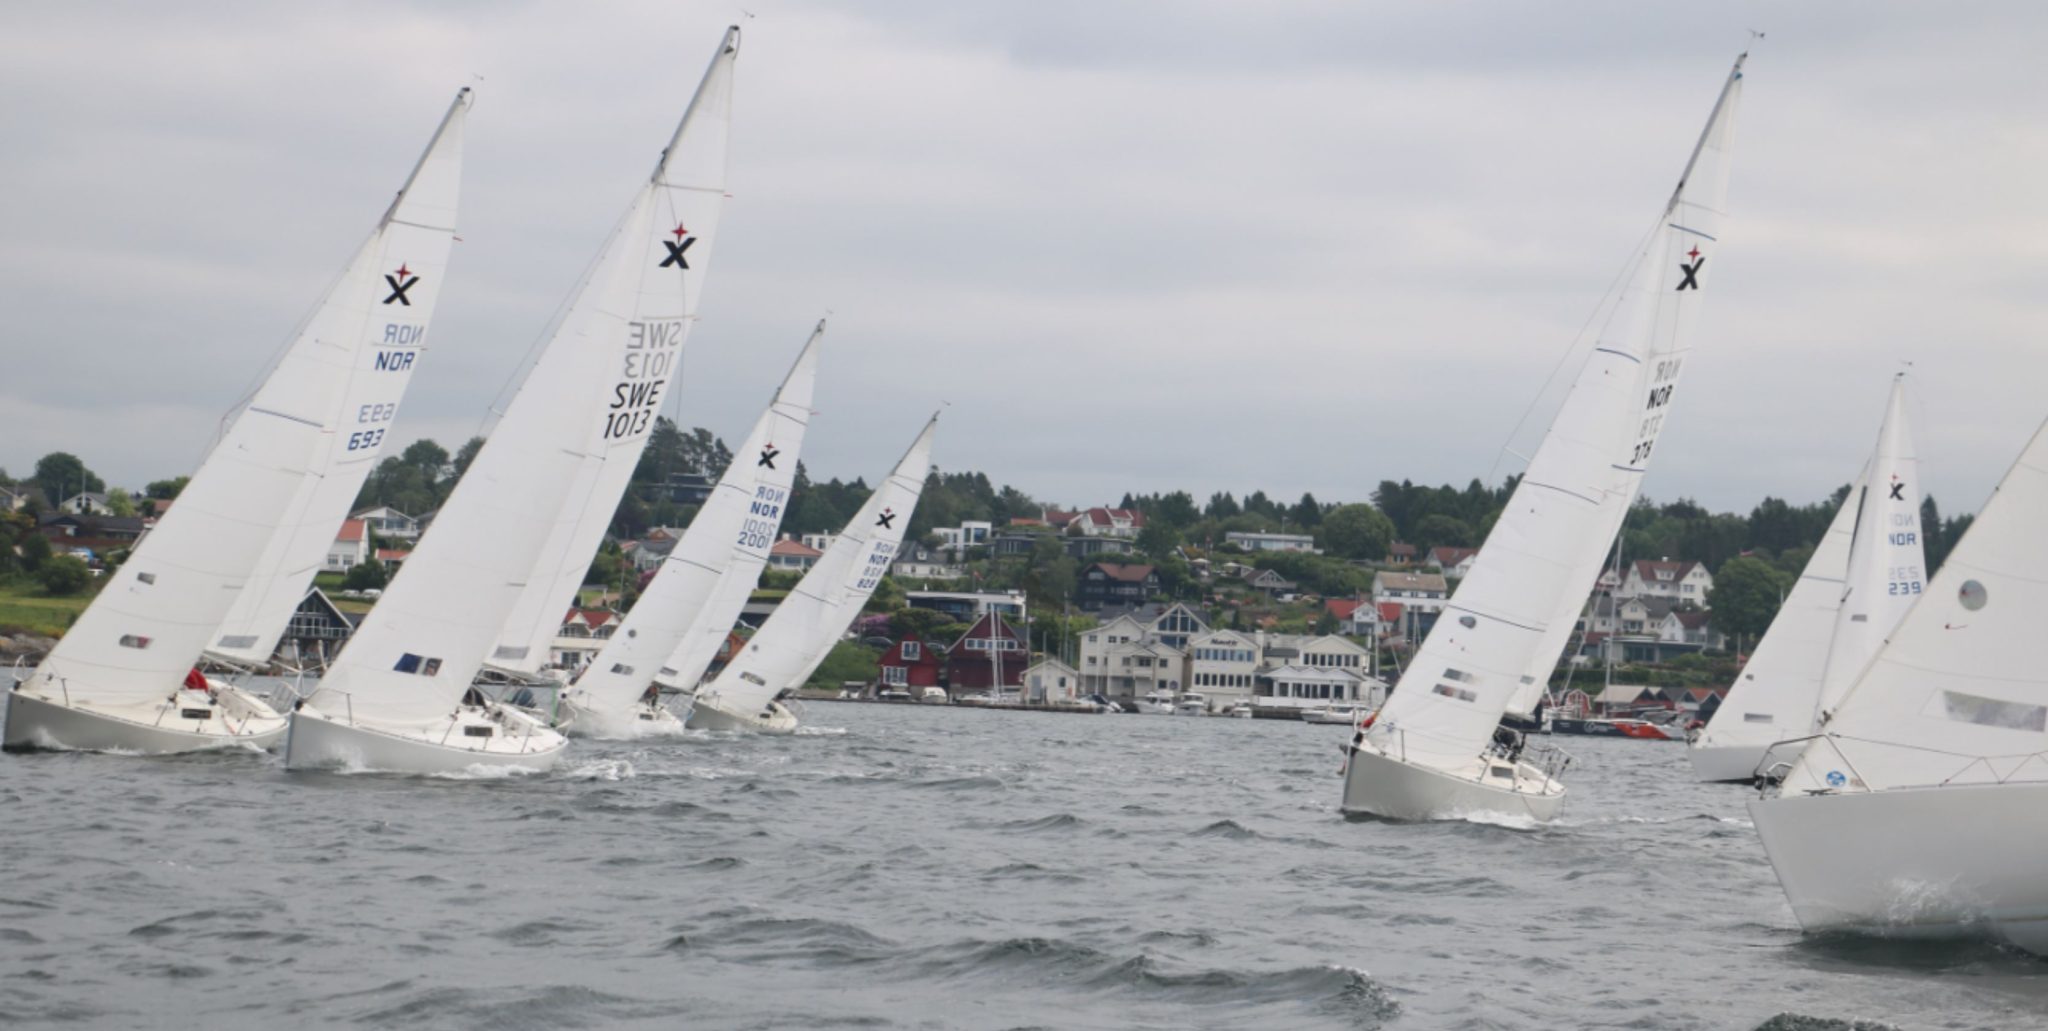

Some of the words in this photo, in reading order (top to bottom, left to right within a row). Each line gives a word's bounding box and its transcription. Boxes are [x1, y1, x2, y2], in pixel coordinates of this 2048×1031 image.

[374, 351, 416, 371] NOR
[610, 379, 664, 410] SWE
[1646, 384, 1673, 410] NOR
[603, 409, 652, 439] 1013
[347, 428, 385, 451] 693
[750, 501, 780, 519] NOR
[737, 531, 771, 549] 2001
[1888, 532, 1917, 546] NOR
[868, 554, 889, 566] NOR
[1888, 581, 1922, 595] 239
